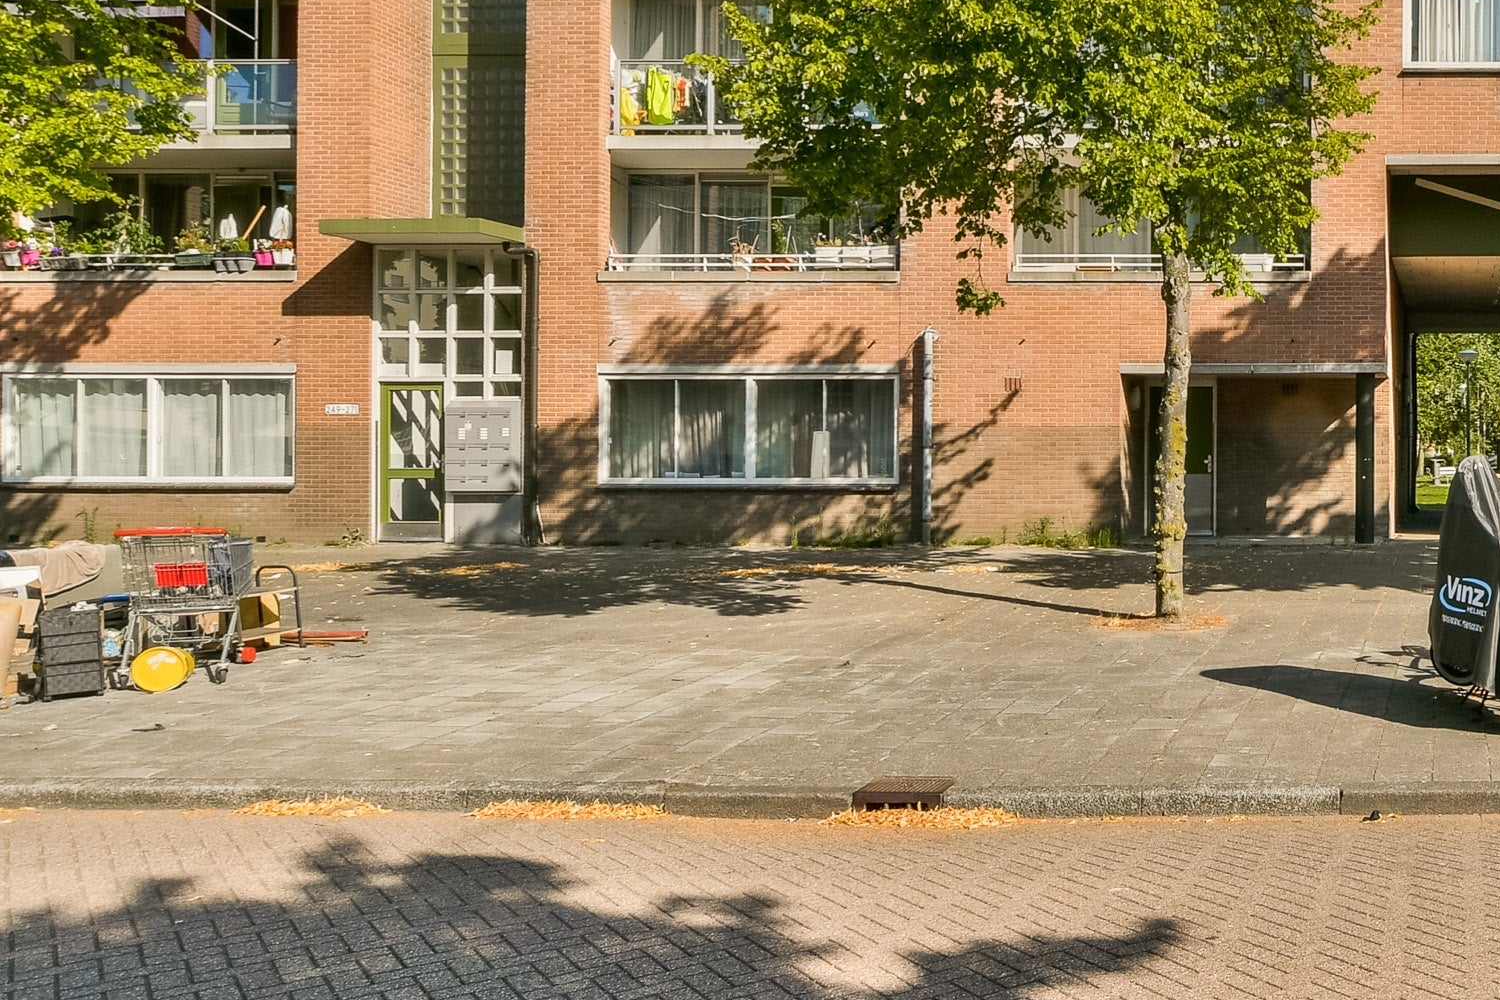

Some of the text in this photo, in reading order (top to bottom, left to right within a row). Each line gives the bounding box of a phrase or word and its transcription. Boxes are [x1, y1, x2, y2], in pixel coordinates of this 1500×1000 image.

[326, 405, 358, 414] 249-271
[1447, 574, 1485, 608] Vinz
[1466, 606, 1487, 617] HELMET
